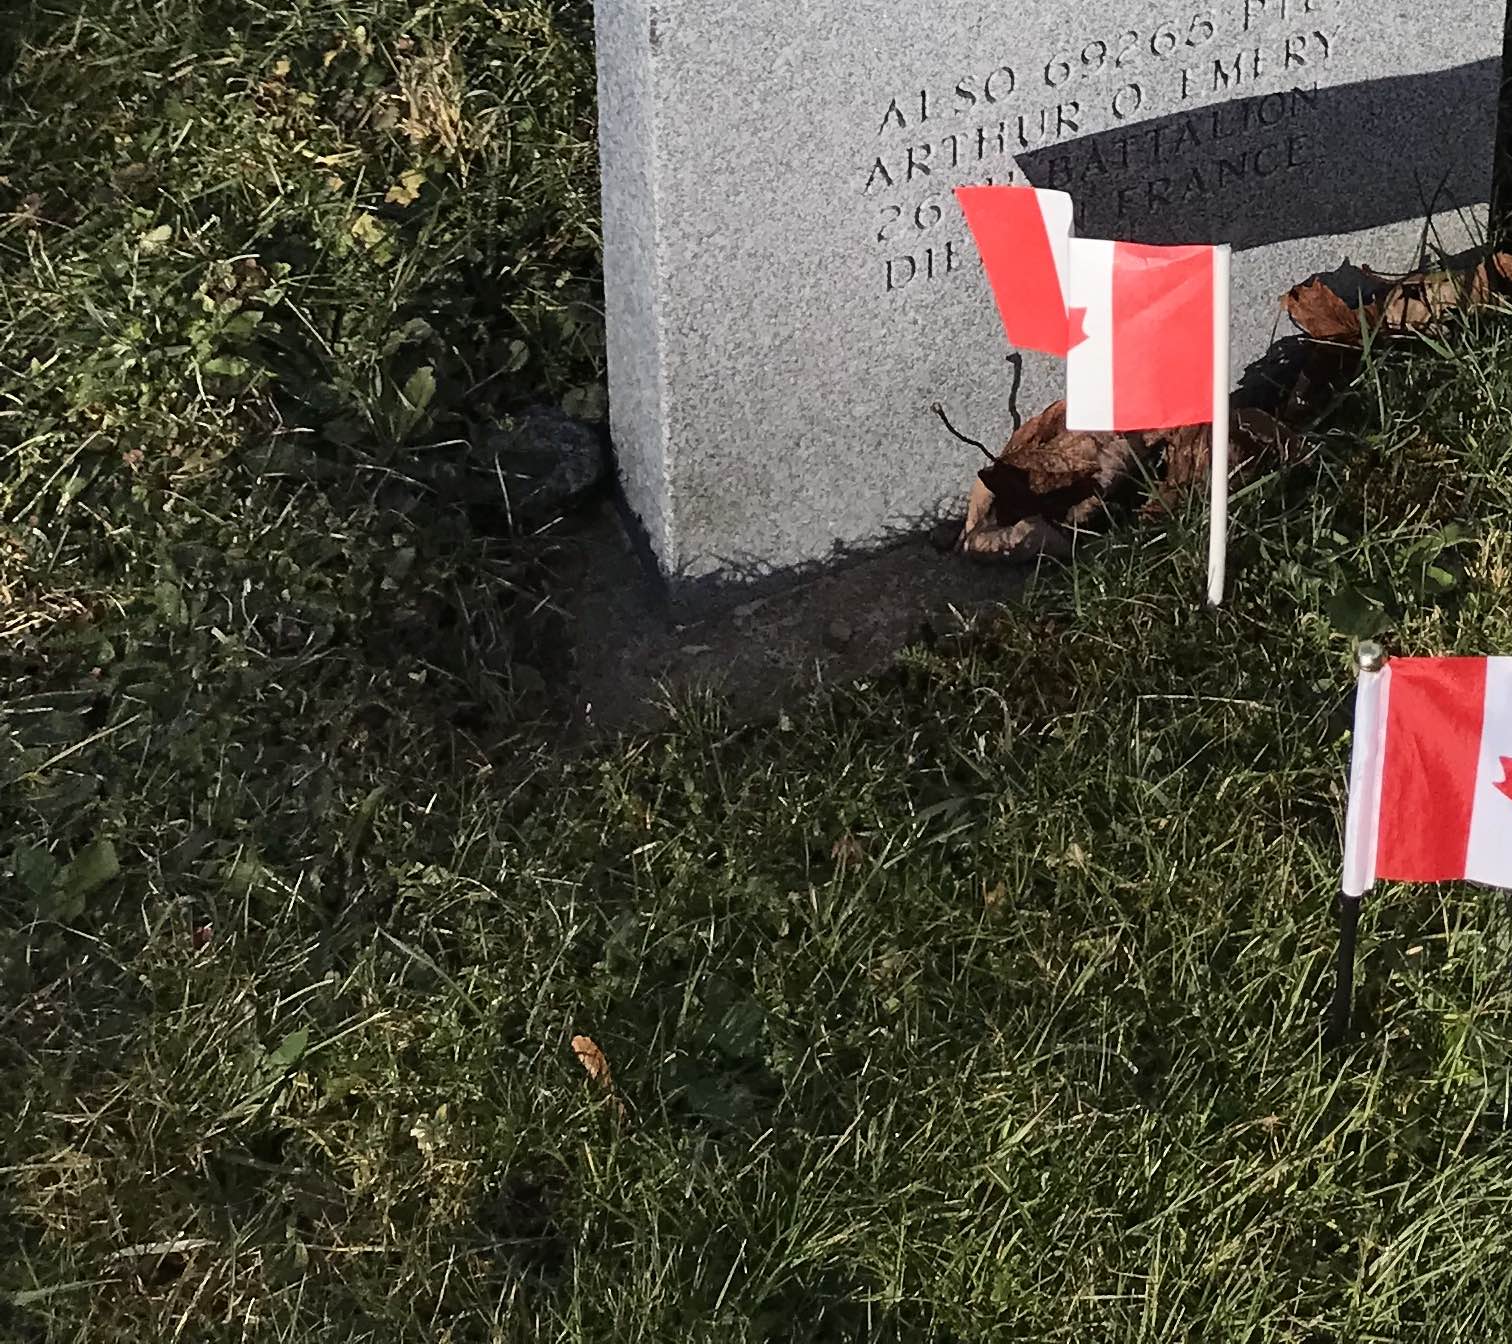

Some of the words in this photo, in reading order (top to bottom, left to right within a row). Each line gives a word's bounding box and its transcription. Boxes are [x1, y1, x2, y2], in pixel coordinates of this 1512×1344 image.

[863, 100, 1080, 196] ARTHUR
[1180, 25, 1341, 102] EMERY
[878, 65, 1016, 136] ALSO
[1043, 12, 1215, 88] 69265
[1049, 81, 1318, 189] BATTALION
[885, 240, 985, 292] DIE
[1116, 134, 1309, 217] FRANCE
